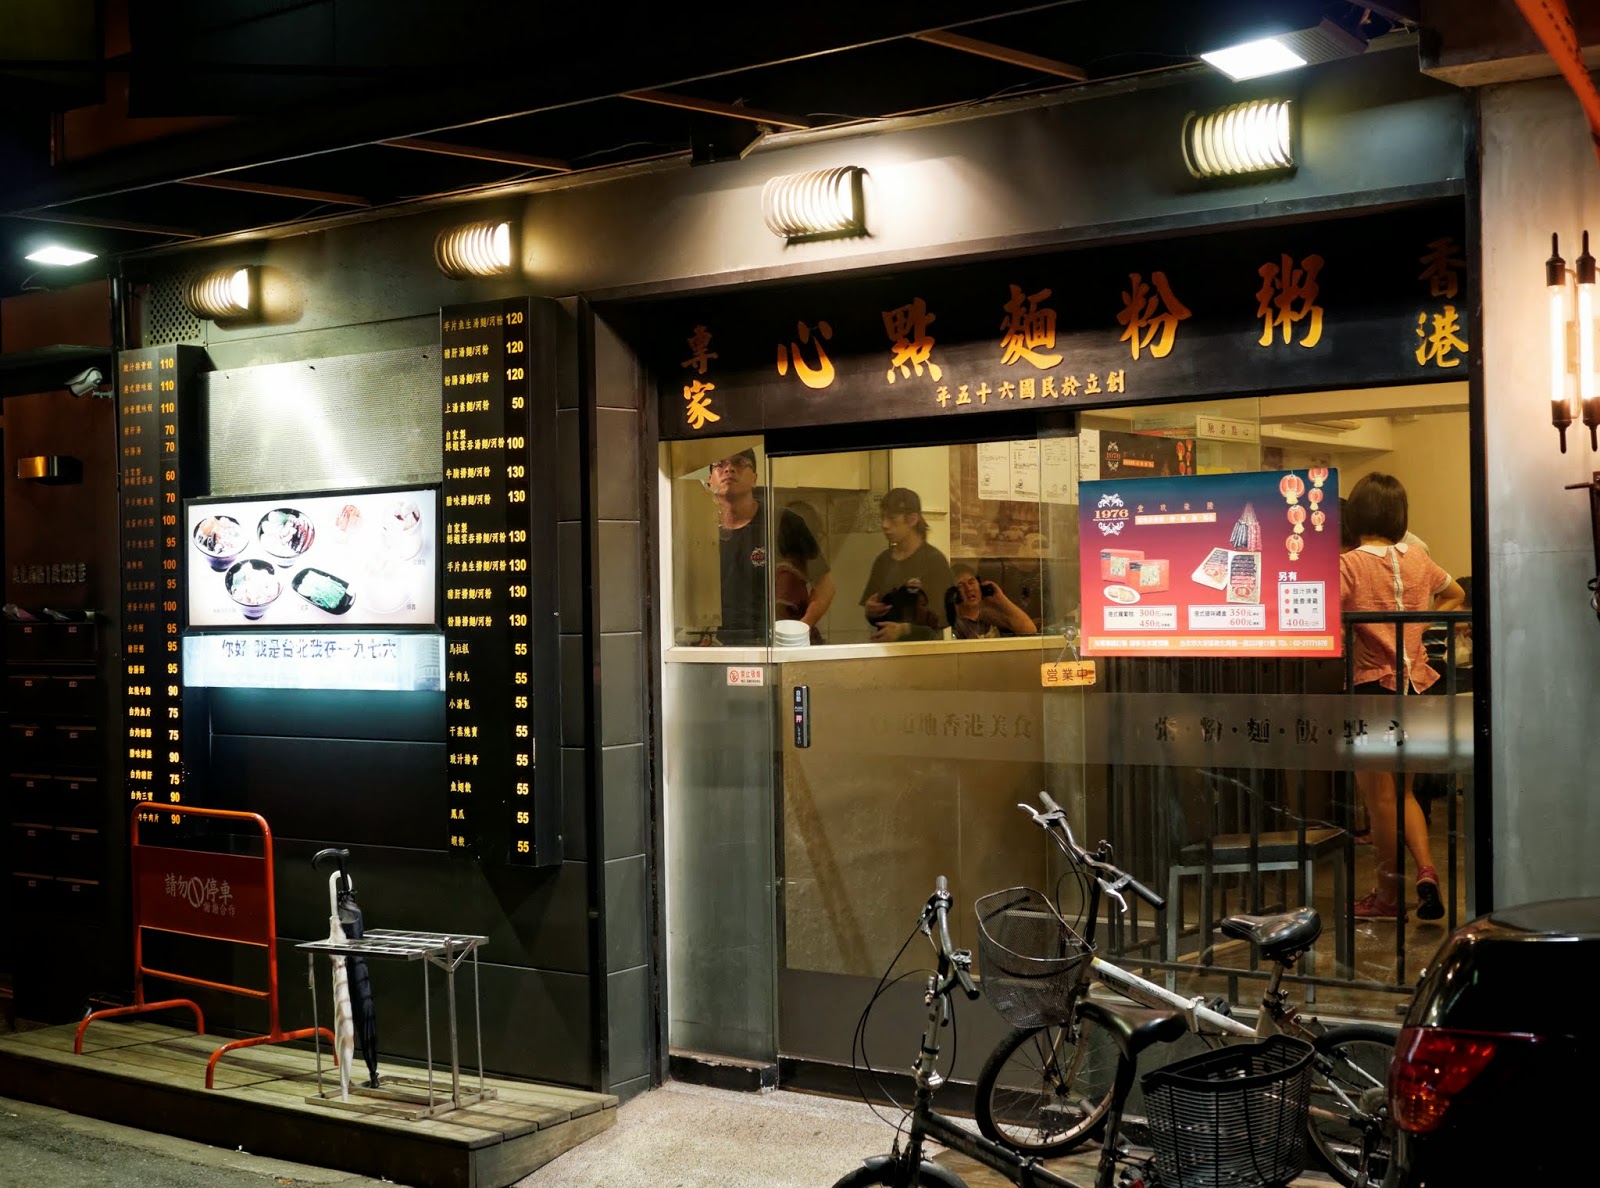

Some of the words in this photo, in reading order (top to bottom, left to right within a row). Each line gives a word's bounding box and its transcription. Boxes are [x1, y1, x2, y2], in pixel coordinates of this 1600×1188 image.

[1415, 237, 1469, 368] 香港
[505, 313, 523, 325] 120
[505, 341, 523, 353] 120
[160, 358, 173, 369] 110
[506, 368, 524, 380] 120
[681, 325, 722, 430] 專家
[160, 380, 173, 391] 110
[160, 402, 174, 413] 110
[511, 397, 524, 409] 50
[165, 424, 174, 435] 70
[165, 441, 174, 452] 70
[506, 437, 524, 449] 100
[165, 470, 175, 481] 60
[506, 465, 524, 477] 130
[165, 492, 175, 503] 70
[507, 490, 525, 502] 130
[1094, 509, 1129, 519] 1976
[162, 515, 175, 526] 100
[508, 530, 526, 542] 130
[166, 537, 175, 547] 95
[163, 559, 176, 570] 100
[508, 559, 526, 571] 130
[1278, 571, 1297, 581] 另有
[166, 578, 176, 589] 95
[508, 585, 526, 597] 130
[163, 601, 176, 611] 100
[509, 614, 526, 626] 130
[167, 623, 176, 634] 95
[167, 641, 176, 651] 95
[222, 639, 246, 658] 你好
[514, 643, 527, 655] 55
[167, 663, 177, 674] 95
[449, 671, 470, 682] 牛肉丸
[514, 672, 527, 683] 55
[168, 685, 177, 696] 90
[514, 696, 527, 708] 55
[168, 707, 178, 718] 75
[168, 730, 178, 741] 75
[515, 725, 528, 737] 55
[169, 752, 179, 763] 90
[516, 754, 528, 766] 55
[169, 774, 179, 785] 75
[516, 782, 528, 794] 55
[170, 792, 179, 802] 90
[171, 814, 180, 824] 90
[517, 811, 529, 823] 55
[517, 840, 529, 852] 55
